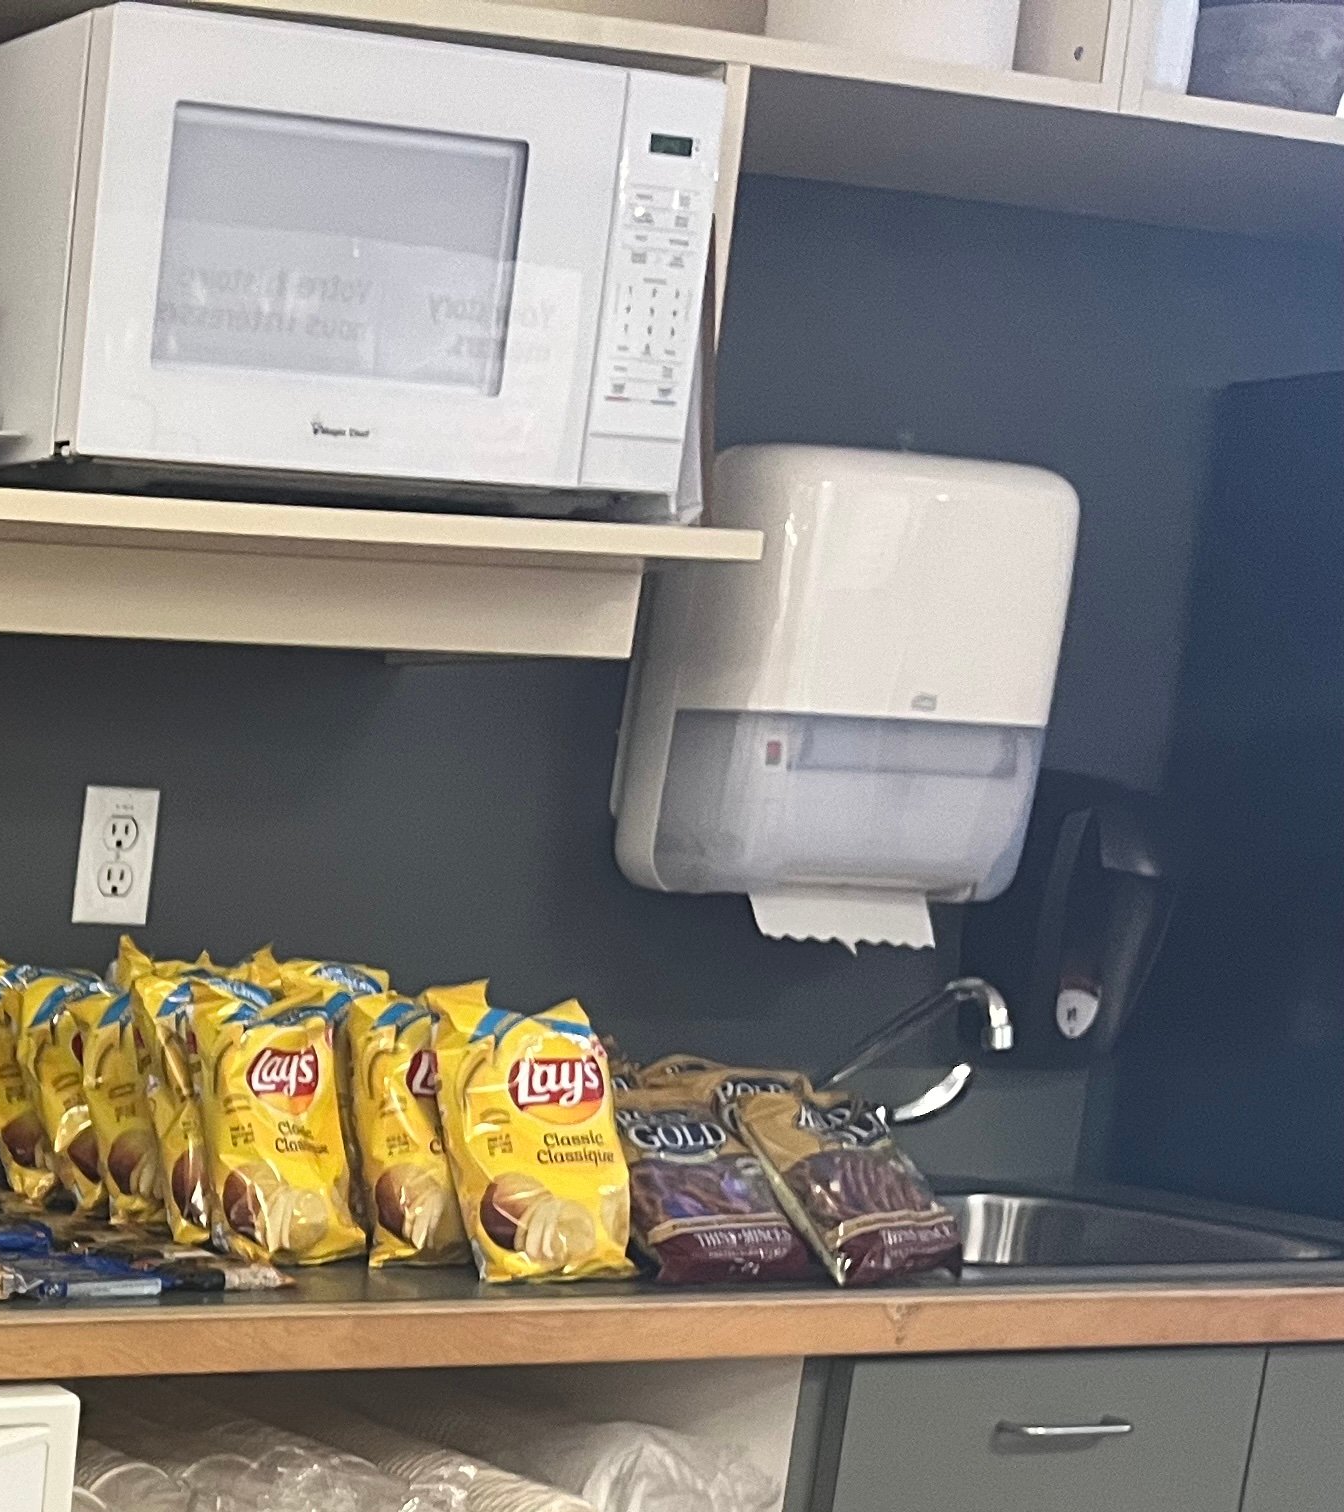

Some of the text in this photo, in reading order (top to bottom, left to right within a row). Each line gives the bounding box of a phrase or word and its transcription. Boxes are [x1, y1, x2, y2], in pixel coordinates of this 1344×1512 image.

[251, 1050, 314, 1096] Lay's
[515, 1056, 600, 1108] Lay's
[543, 1130, 604, 1147] Classic
[628, 1122, 727, 1149] GOLD
[536, 1149, 614, 1167] Classique
